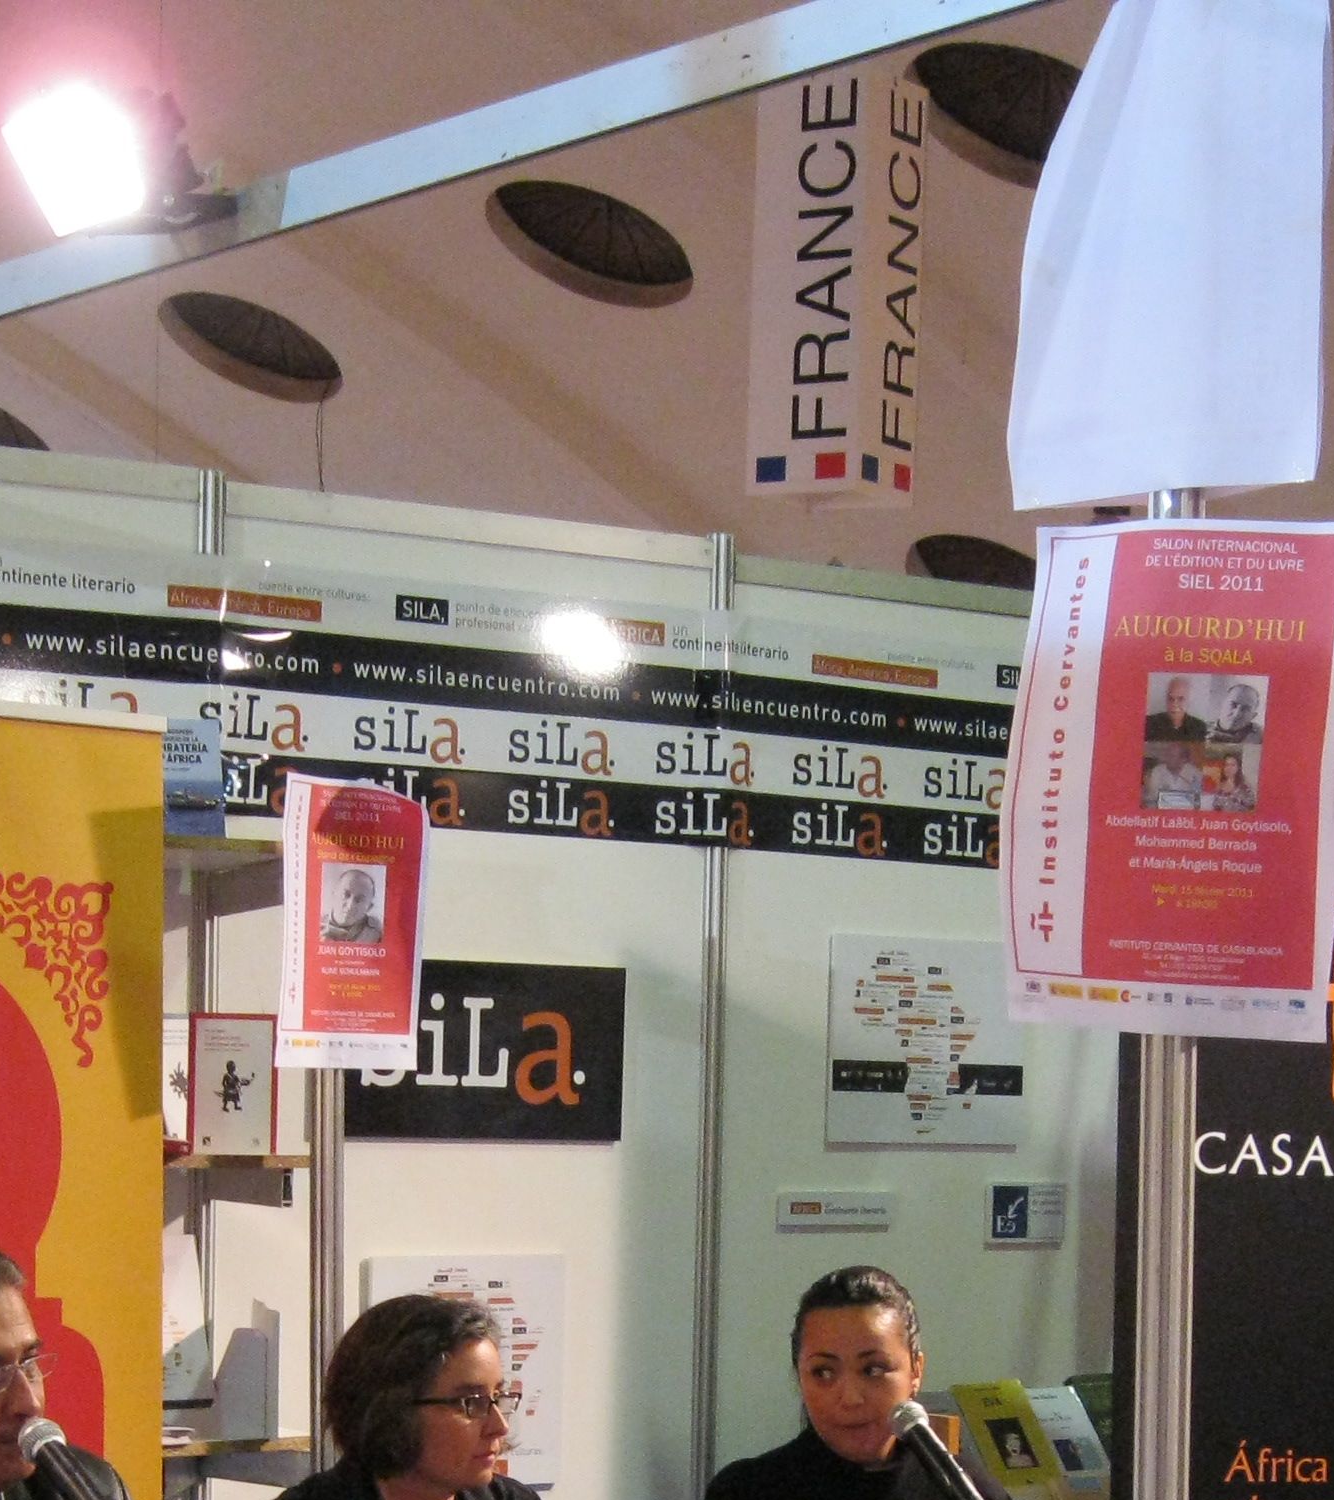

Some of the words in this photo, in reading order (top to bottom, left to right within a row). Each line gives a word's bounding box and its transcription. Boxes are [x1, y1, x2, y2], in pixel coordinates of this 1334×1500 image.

[791, 78, 858, 440] FRANCE
[882, 87, 923, 451] FRANCE
[1153, 537, 1194, 551] SALON
[1197, 538, 1298, 554] INTERNACIONAL
[1146, 554, 1160, 566] DE
[1164, 552, 1223, 568] L'ÉDITION
[1227, 557, 1242, 569] ET
[1246, 557, 1264, 570] DU
[1268, 558, 1305, 572] LIVRE
[72, 573, 136, 594] literario
[1178, 573, 1215, 590] SIEL
[1219, 575, 1264, 592] 2011
[268, 601, 312, 619] Europa
[402, 600, 445, 624] SILA,
[487, 604, 501, 616] de
[672, 625, 688, 636] un
[1114, 614, 1307, 642] AUJOURD'HUI
[26, 632, 319, 674] www.silaencuero.com
[353, 661, 620, 701] www.silaencuentro.com
[1164, 646, 1174, 663] à
[1179, 647, 1193, 663] la
[1198, 648, 1253, 667] SQALA
[1039, 727, 1067, 886] Instituto
[1053, 556, 1091, 711] Cervantes
[1105, 814, 1158, 828] Abdellatif
[1200, 818, 1228, 831] Juan
[1232, 818, 1292, 835] Goytisolo,
[1135, 835, 1205, 849] Mohammed
[1208, 837, 1258, 851] Berrada
[1129, 857, 1139, 868] et
[1222, 859, 1263, 875] Roque
[1153, 941, 1205, 954] CERVANTES
[1207, 944, 1219, 954] DE
[1222, 944, 1283, 957] CASABLANCA
[1195, 1131, 1334, 1177] CASA
[1223, 1439, 1328, 1483] África
